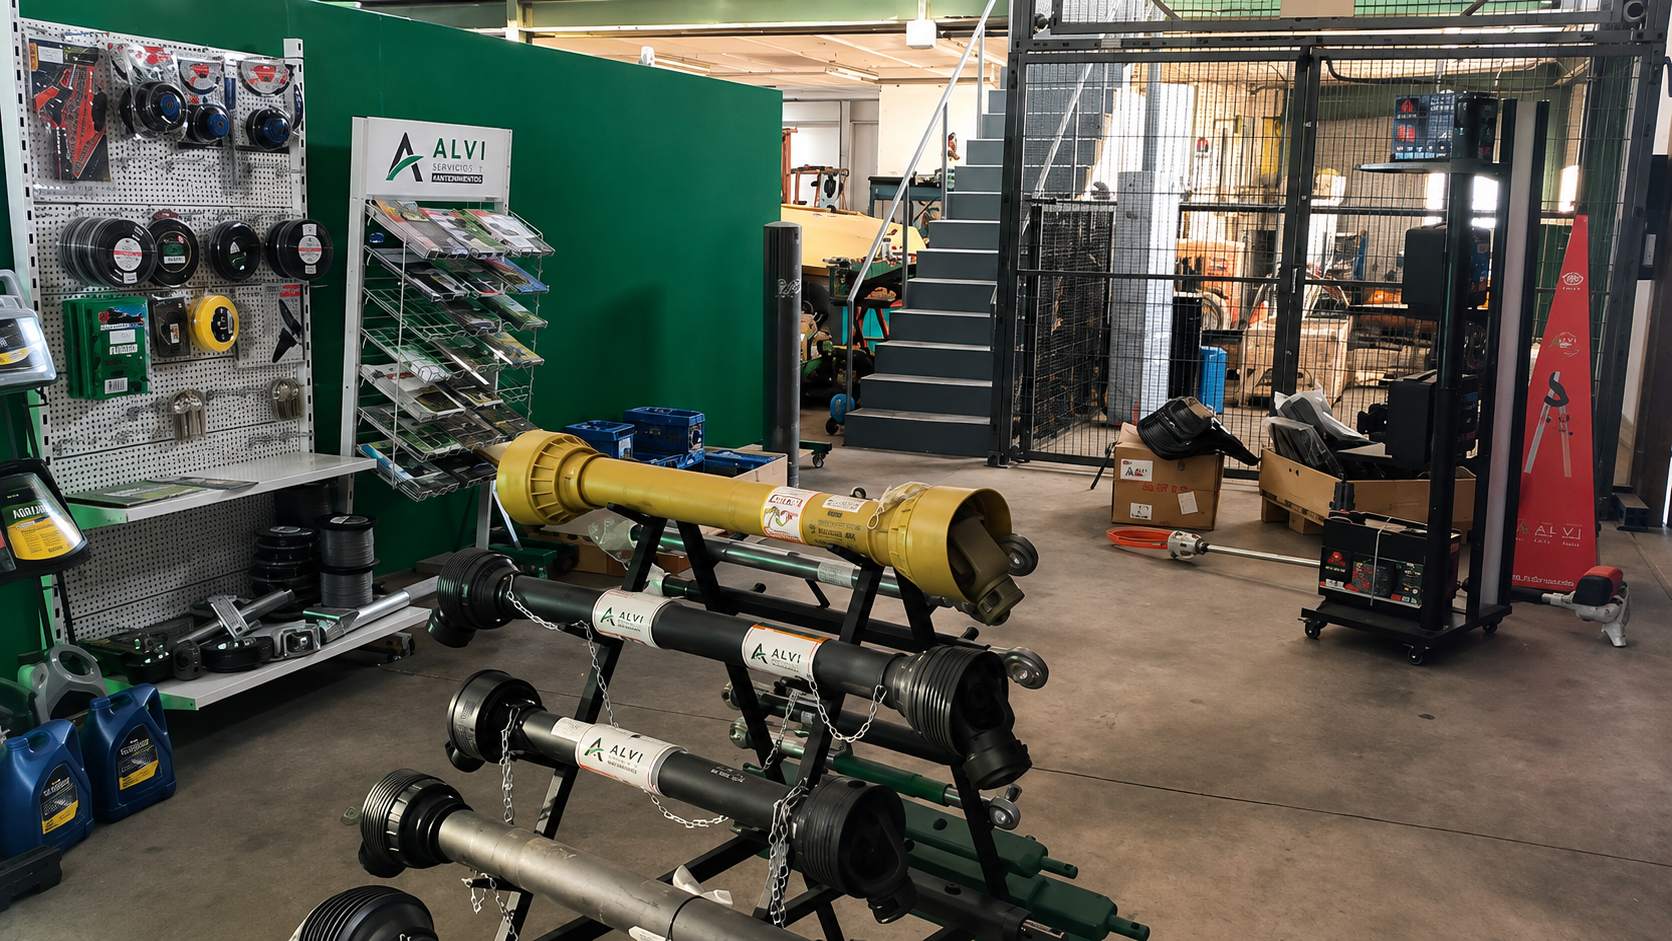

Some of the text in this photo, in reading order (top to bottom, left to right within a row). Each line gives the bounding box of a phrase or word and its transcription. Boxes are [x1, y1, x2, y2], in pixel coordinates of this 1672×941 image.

[432, 137, 485, 160] ALVI
[432, 163, 473, 173] SERVICIOS
[619, 611, 644, 624] ALVI
[771, 648, 801, 664] ALVI
[609, 744, 643, 763] ALVI
